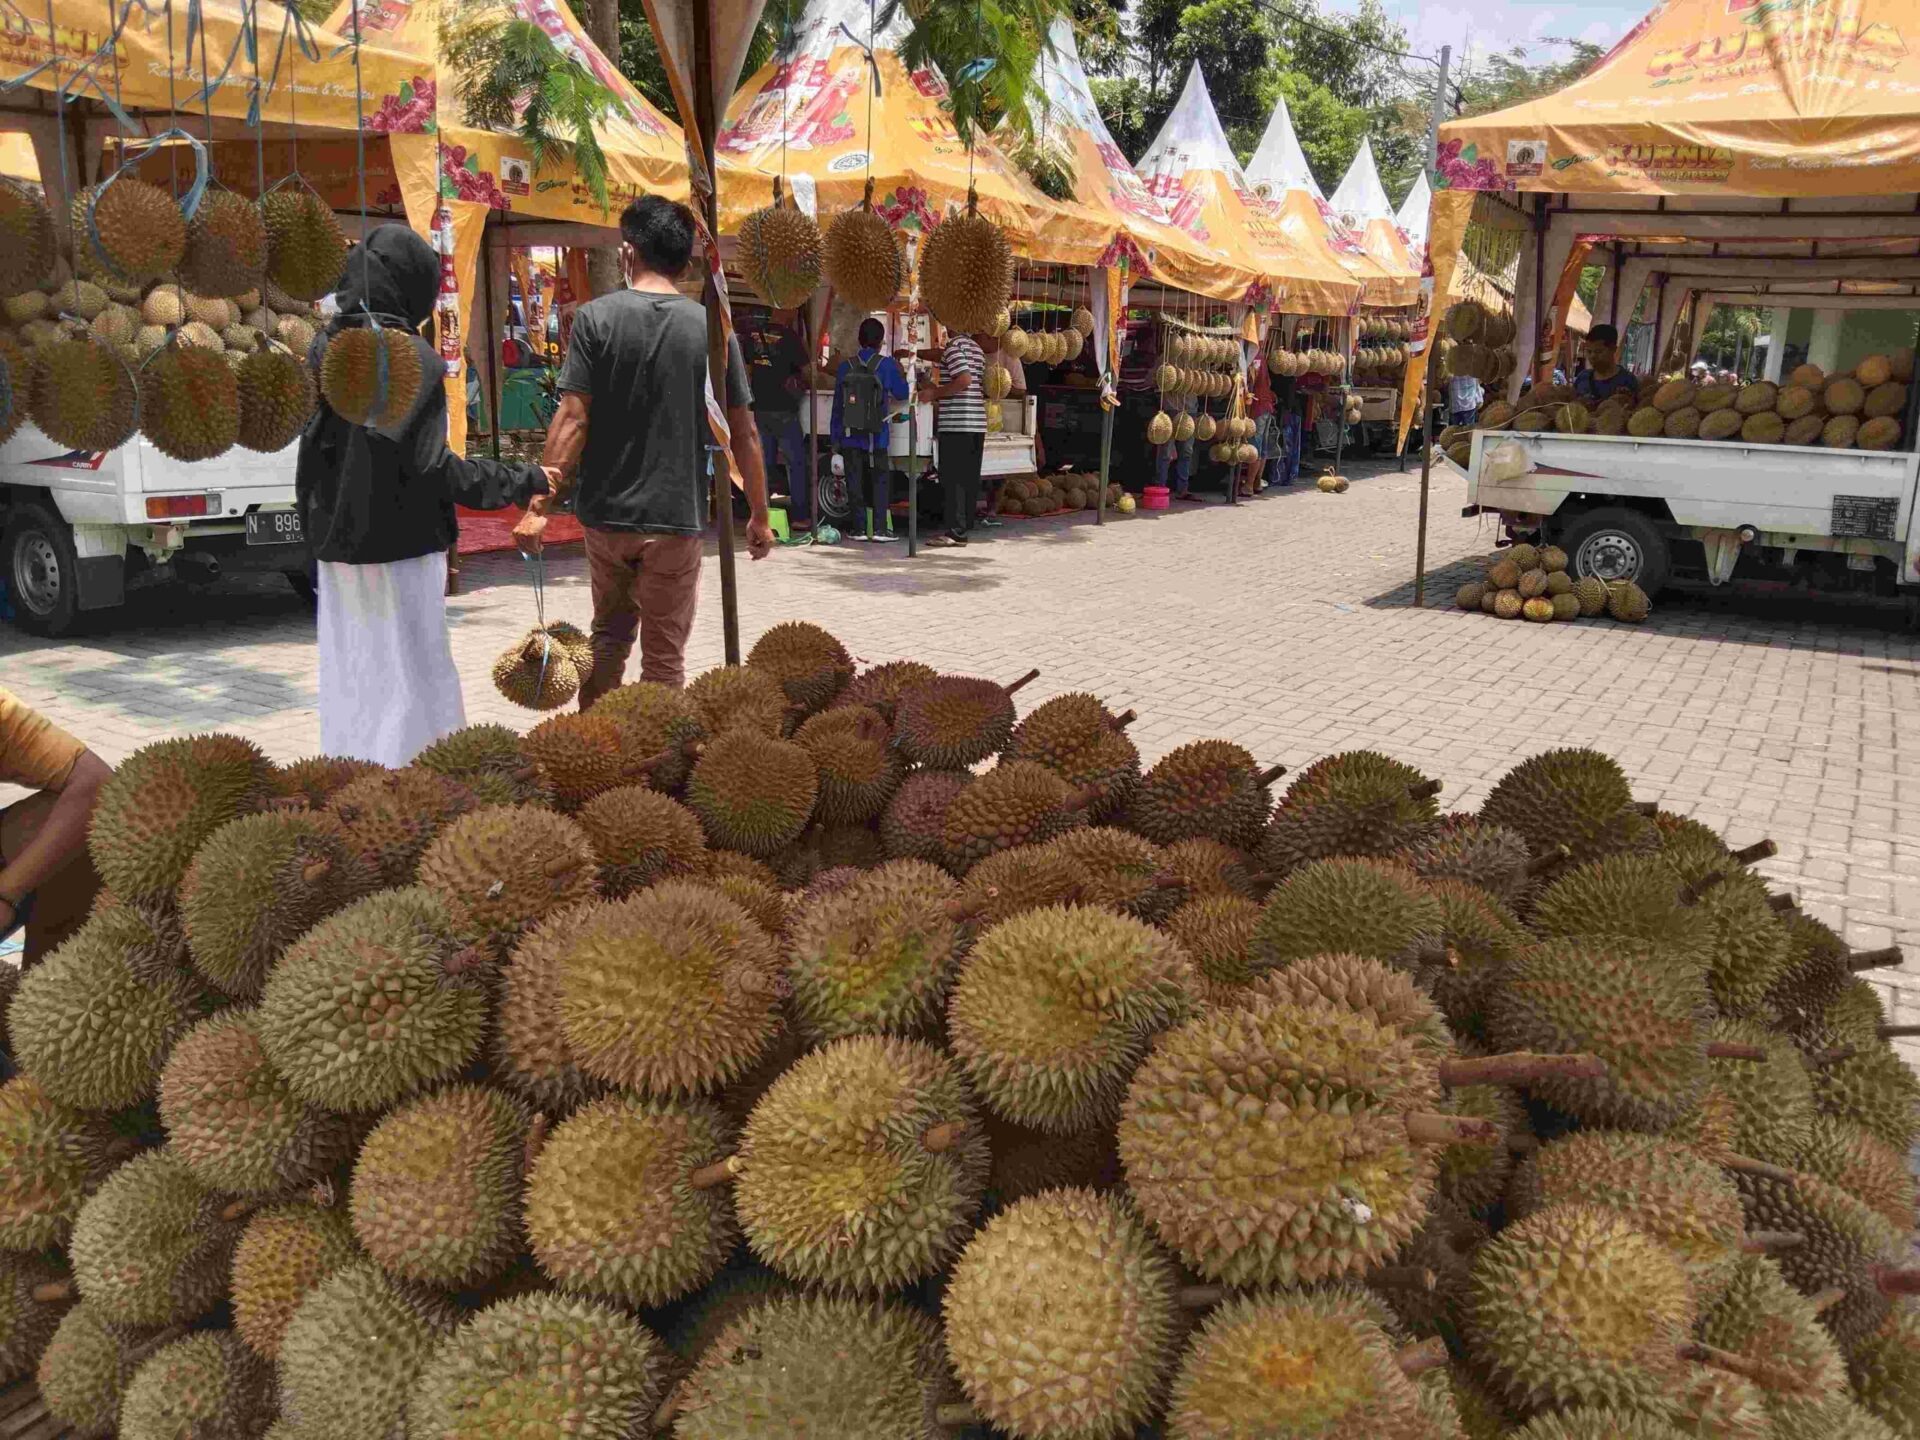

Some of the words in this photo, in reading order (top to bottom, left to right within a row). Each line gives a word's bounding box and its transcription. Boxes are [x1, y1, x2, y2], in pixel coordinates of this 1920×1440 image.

[1605, 142, 1735, 169] KURNIA
[72, 461, 93, 469] CARRY
[248, 515, 258, 534] N
